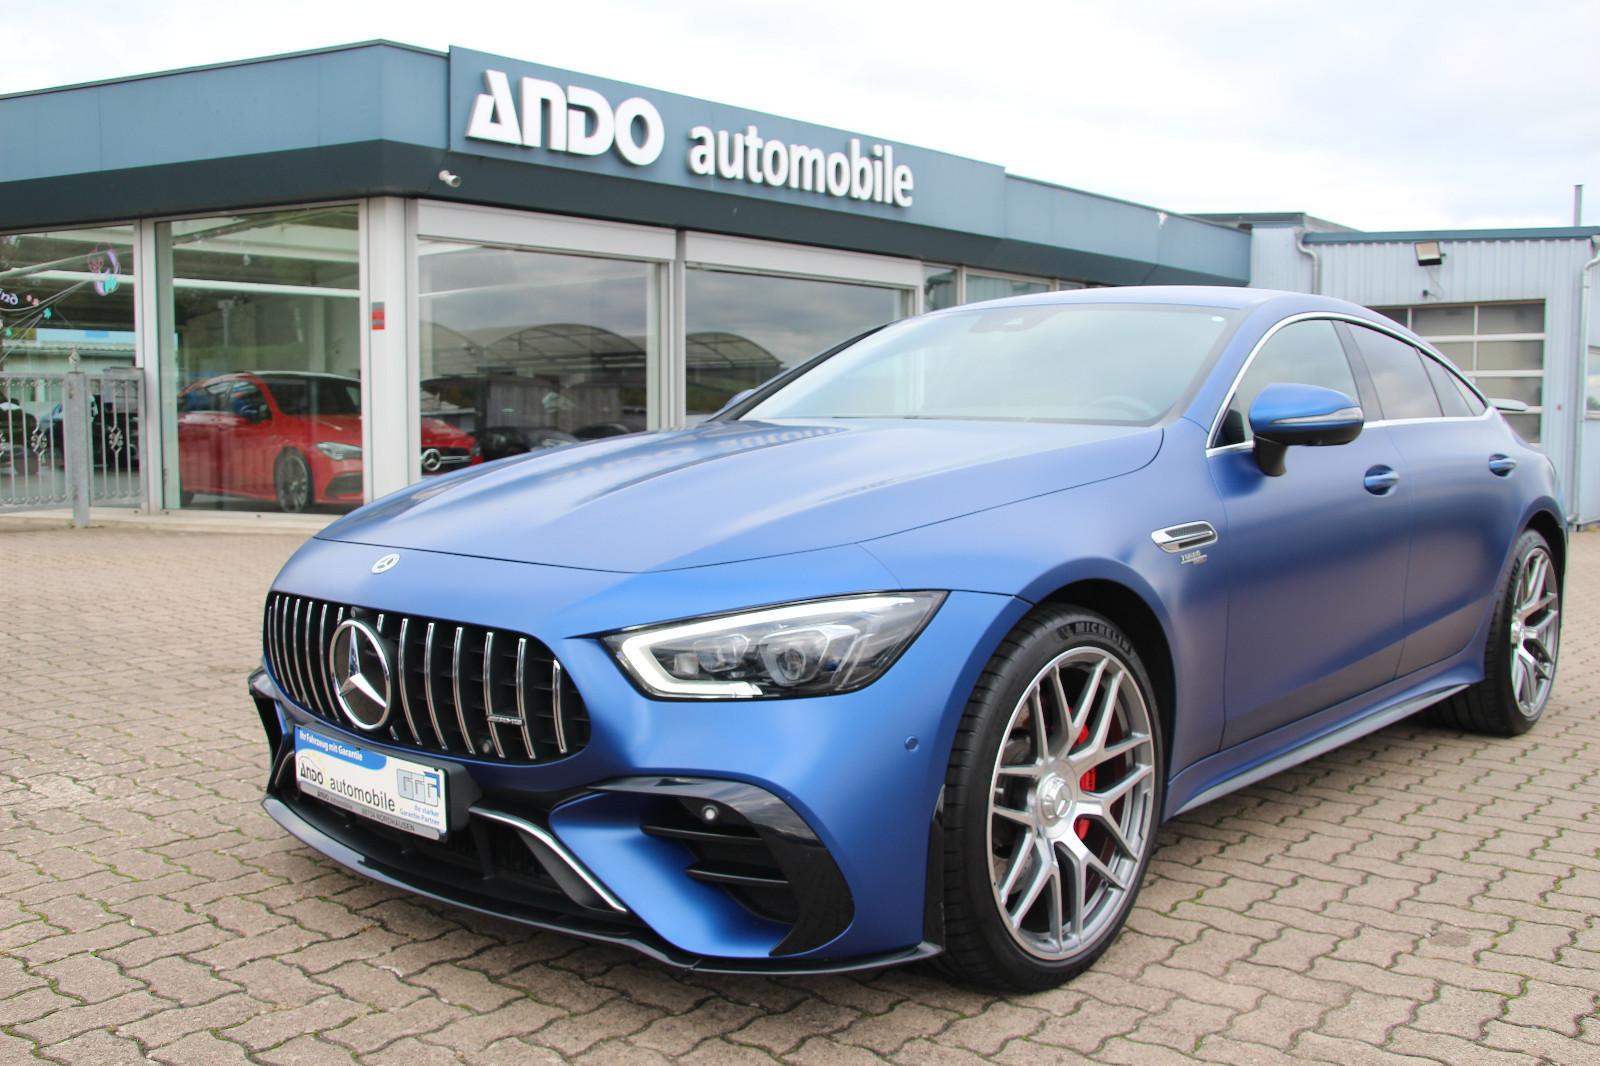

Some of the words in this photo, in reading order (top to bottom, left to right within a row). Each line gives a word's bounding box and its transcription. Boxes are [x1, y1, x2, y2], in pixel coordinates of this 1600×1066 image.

[465, 69, 665, 167] ANDO
[688, 125, 914, 207] automobile
[306, 732, 329, 752] Fahrzeug
[338, 745, 363, 761] Garantie
[329, 776, 396, 812] automobile
